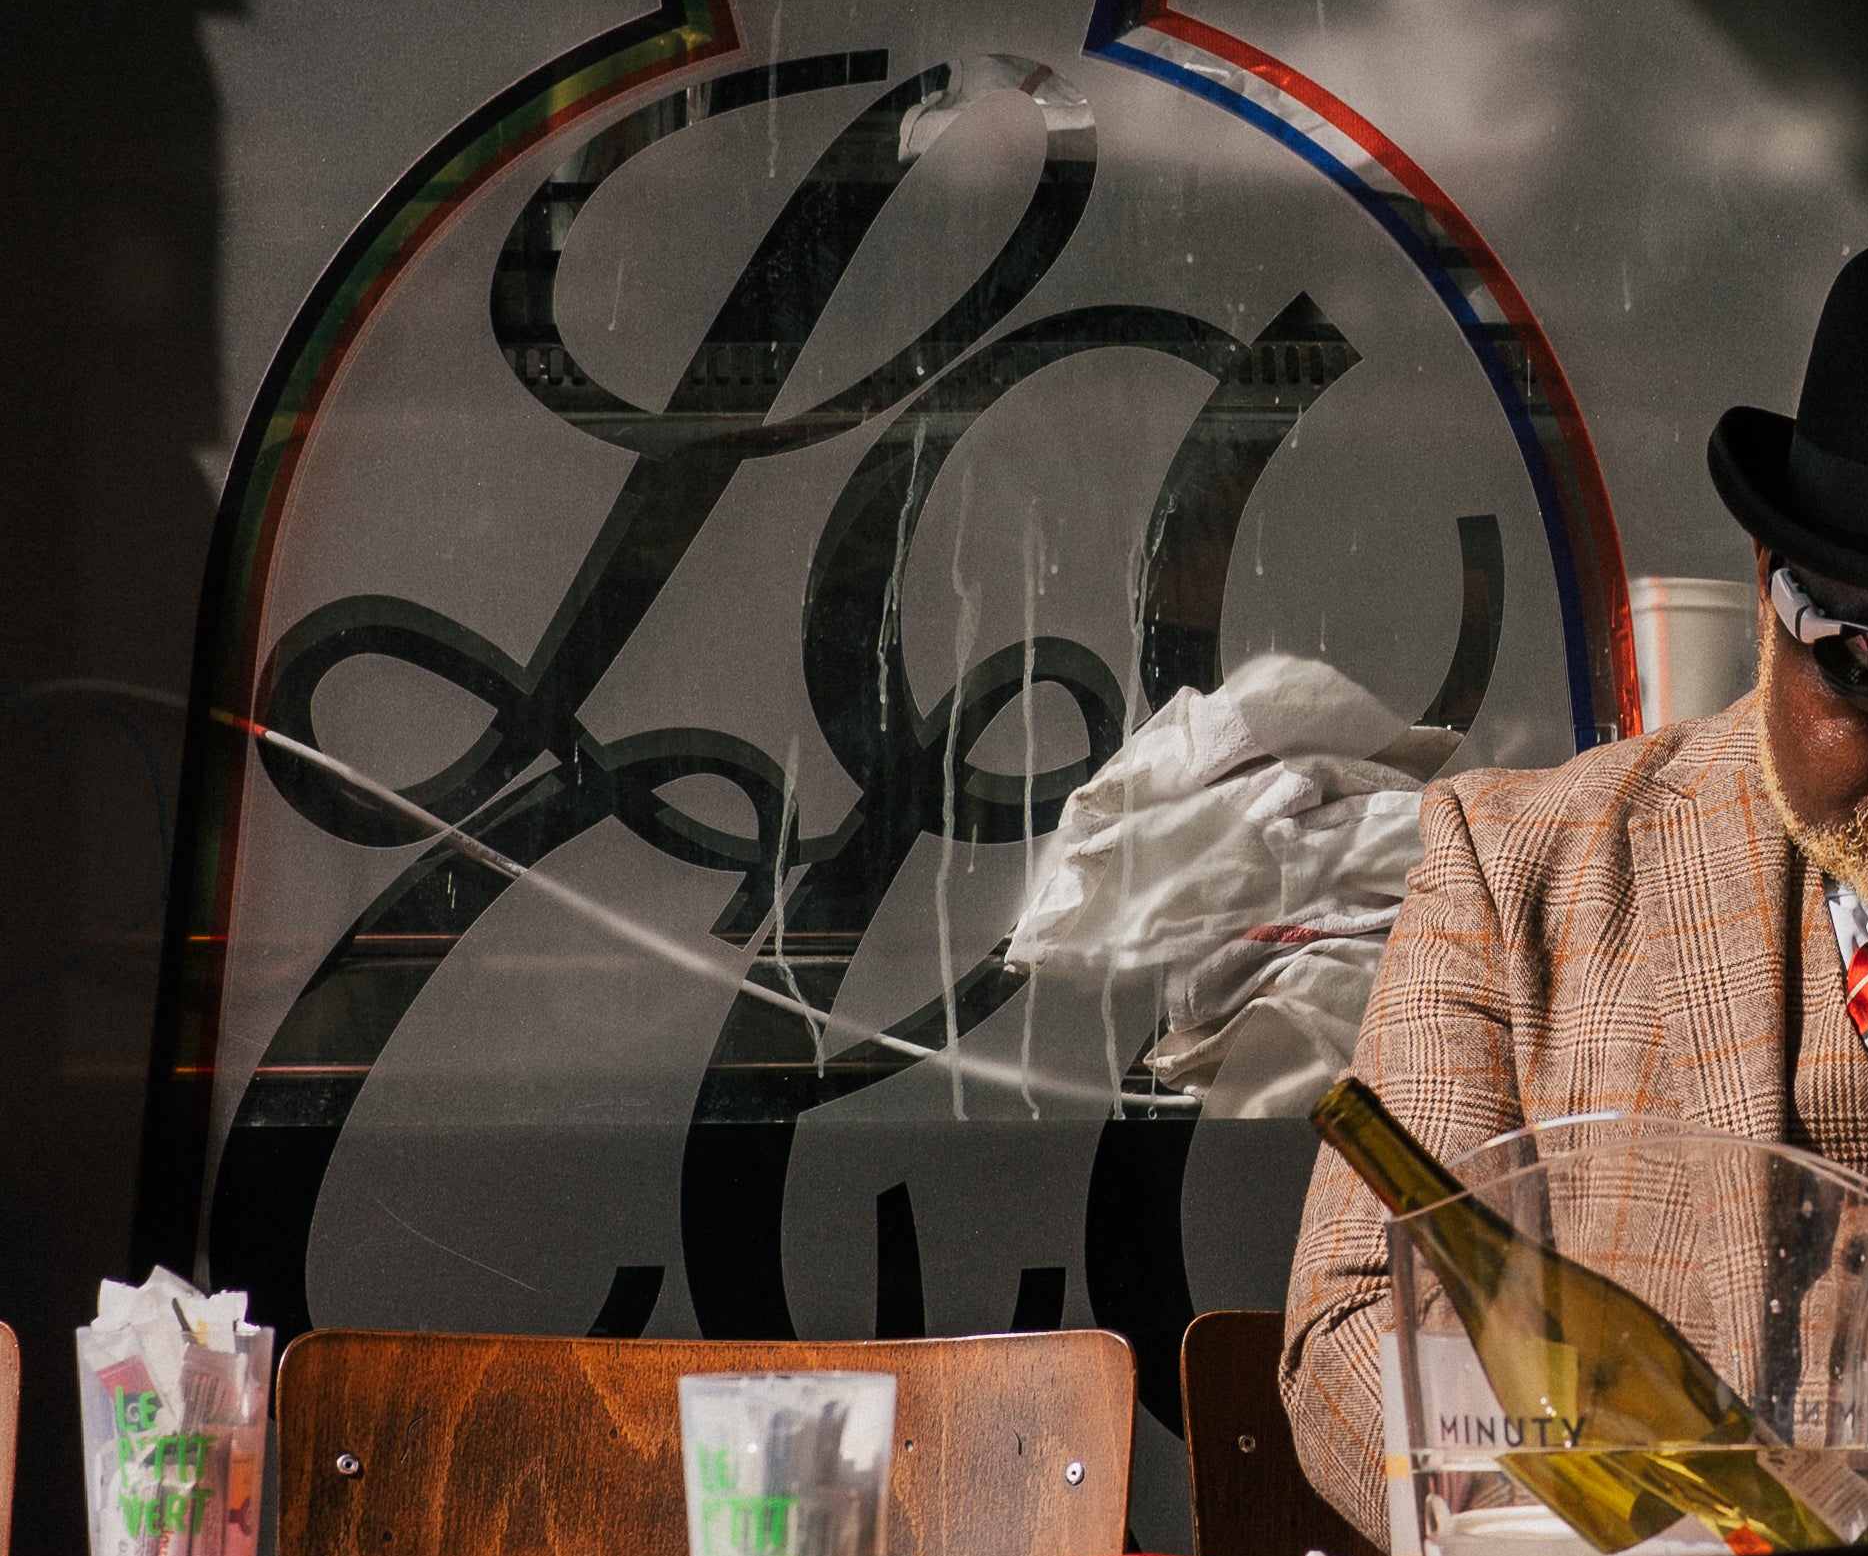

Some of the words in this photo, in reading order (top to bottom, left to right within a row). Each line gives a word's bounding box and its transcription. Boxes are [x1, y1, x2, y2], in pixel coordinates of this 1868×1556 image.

[115, 1385, 157, 1432] LE
[1440, 1415, 1587, 1447] MINUTY
[118, 1489, 216, 1537] VERT
